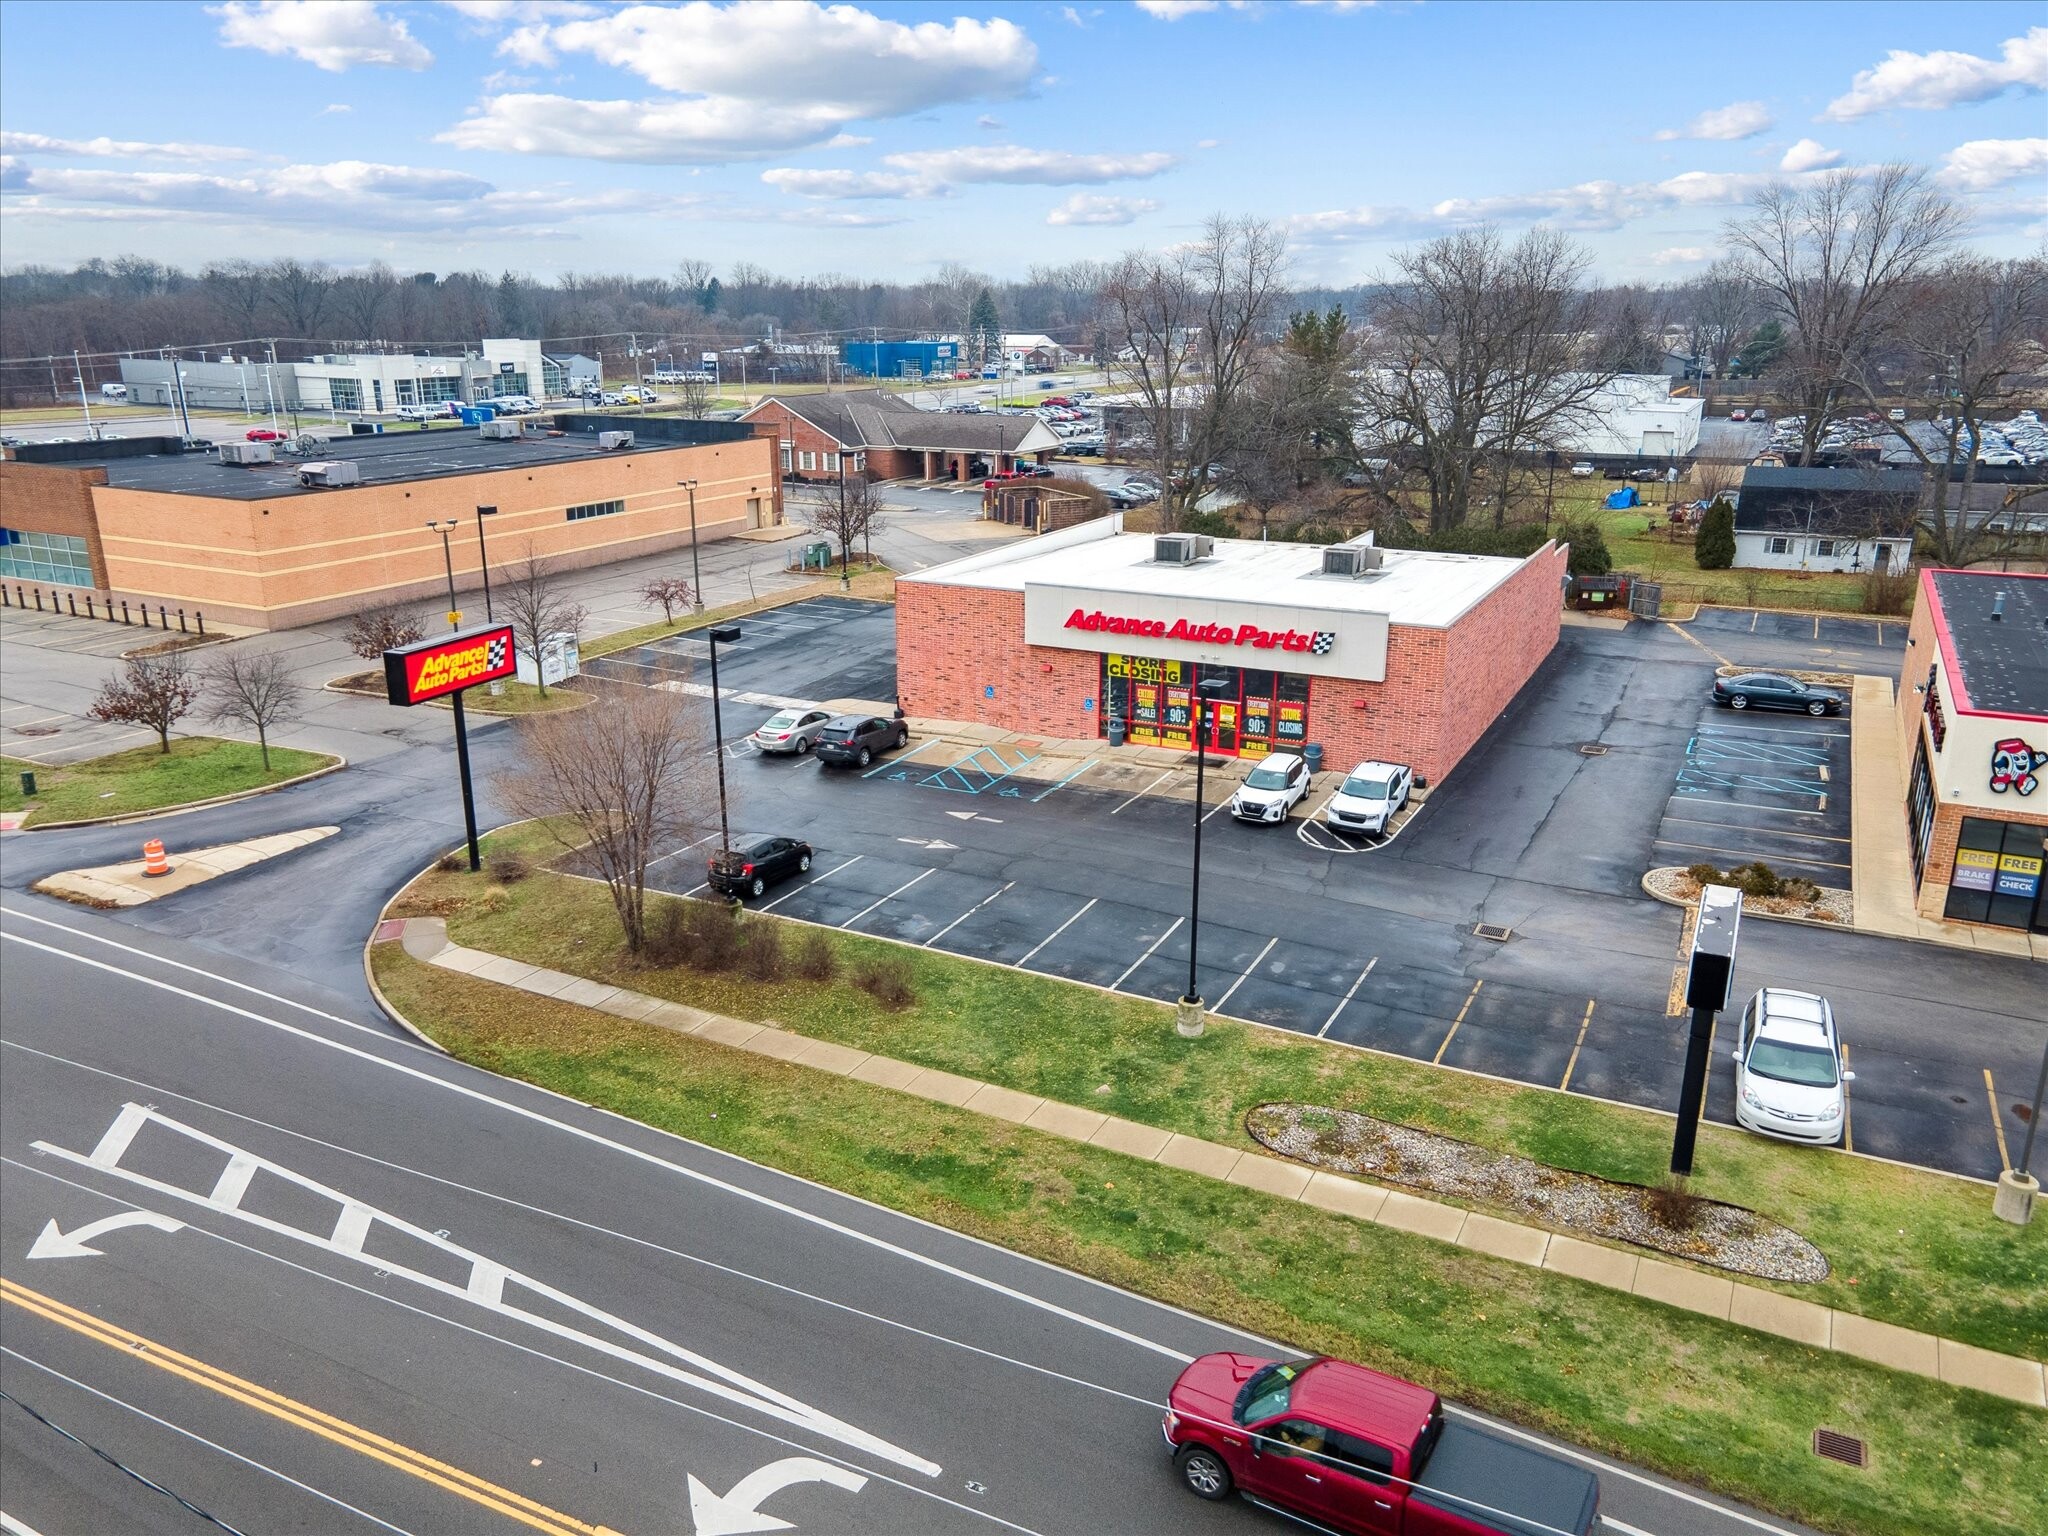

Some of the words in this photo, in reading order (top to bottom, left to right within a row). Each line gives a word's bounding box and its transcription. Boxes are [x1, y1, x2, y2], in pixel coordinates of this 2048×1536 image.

[1064, 609, 1166, 638] Advance
[1166, 619, 1233, 644] Auto
[1235, 625, 1308, 653] Parts
[421, 646, 484, 676] Advance
[1121, 655, 1167, 669] STORE
[413, 671, 448, 693] Auto
[449, 662, 484, 682] Parts
[1109, 663, 1179, 682] CLOSING
[1281, 708, 1301, 720] STORE
[1135, 727, 1154, 736] FREE
[1279, 721, 1302, 734] CLOSING
[1167, 731, 1187, 740] FREE
[1246, 742, 1267, 750] FREE
[1961, 852, 1994, 864] FREE
[2004, 858, 2038, 870] FREE
[1957, 869, 1991, 880] BRAKE
[1999, 880, 2033, 891] CHECK
